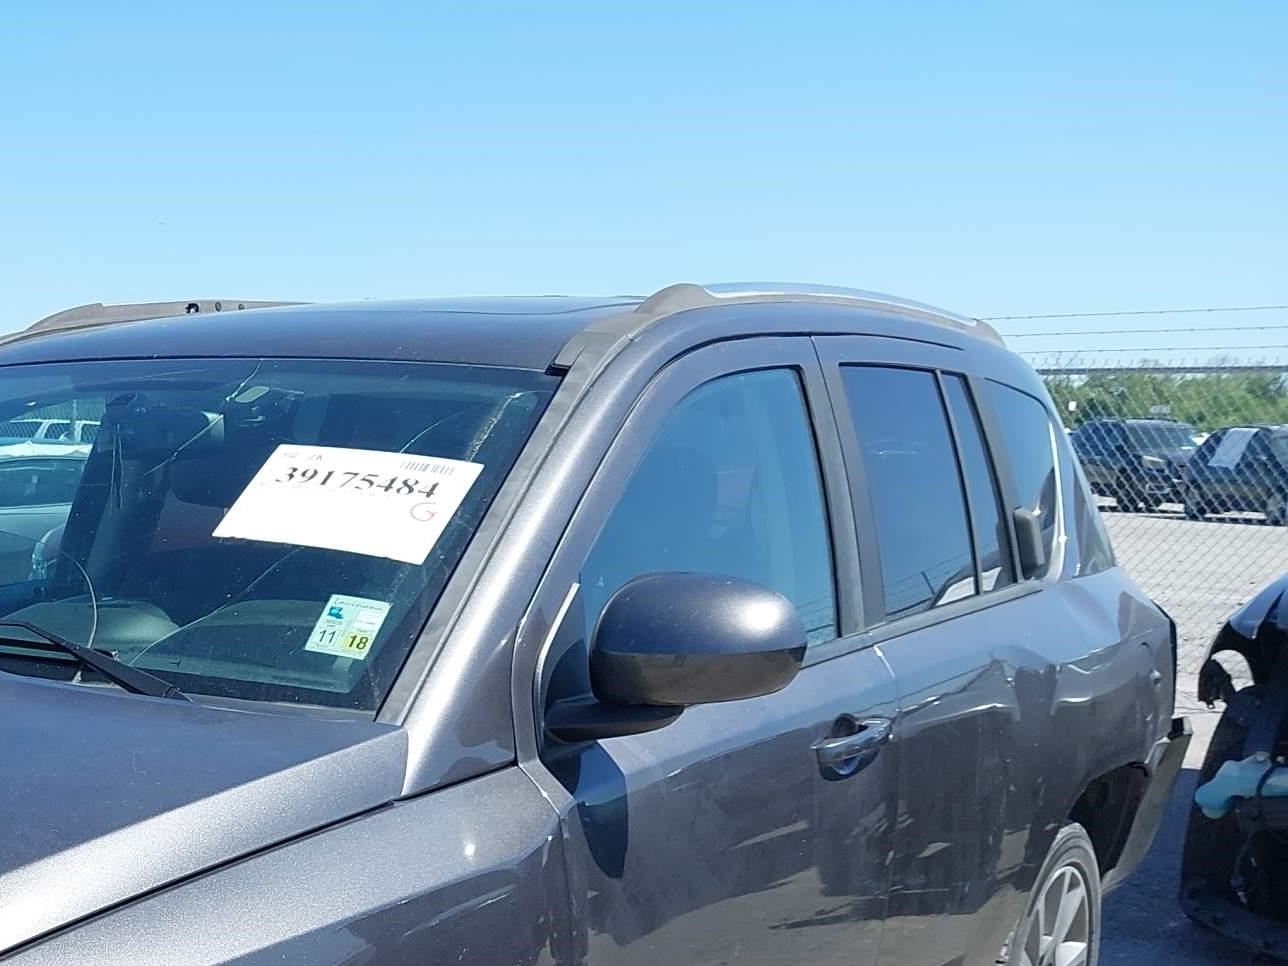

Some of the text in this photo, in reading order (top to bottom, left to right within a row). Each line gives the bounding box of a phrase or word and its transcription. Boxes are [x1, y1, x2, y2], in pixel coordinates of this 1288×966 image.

[276, 466, 440, 498] 39175484
[319, 629, 370, 650] 11 18
